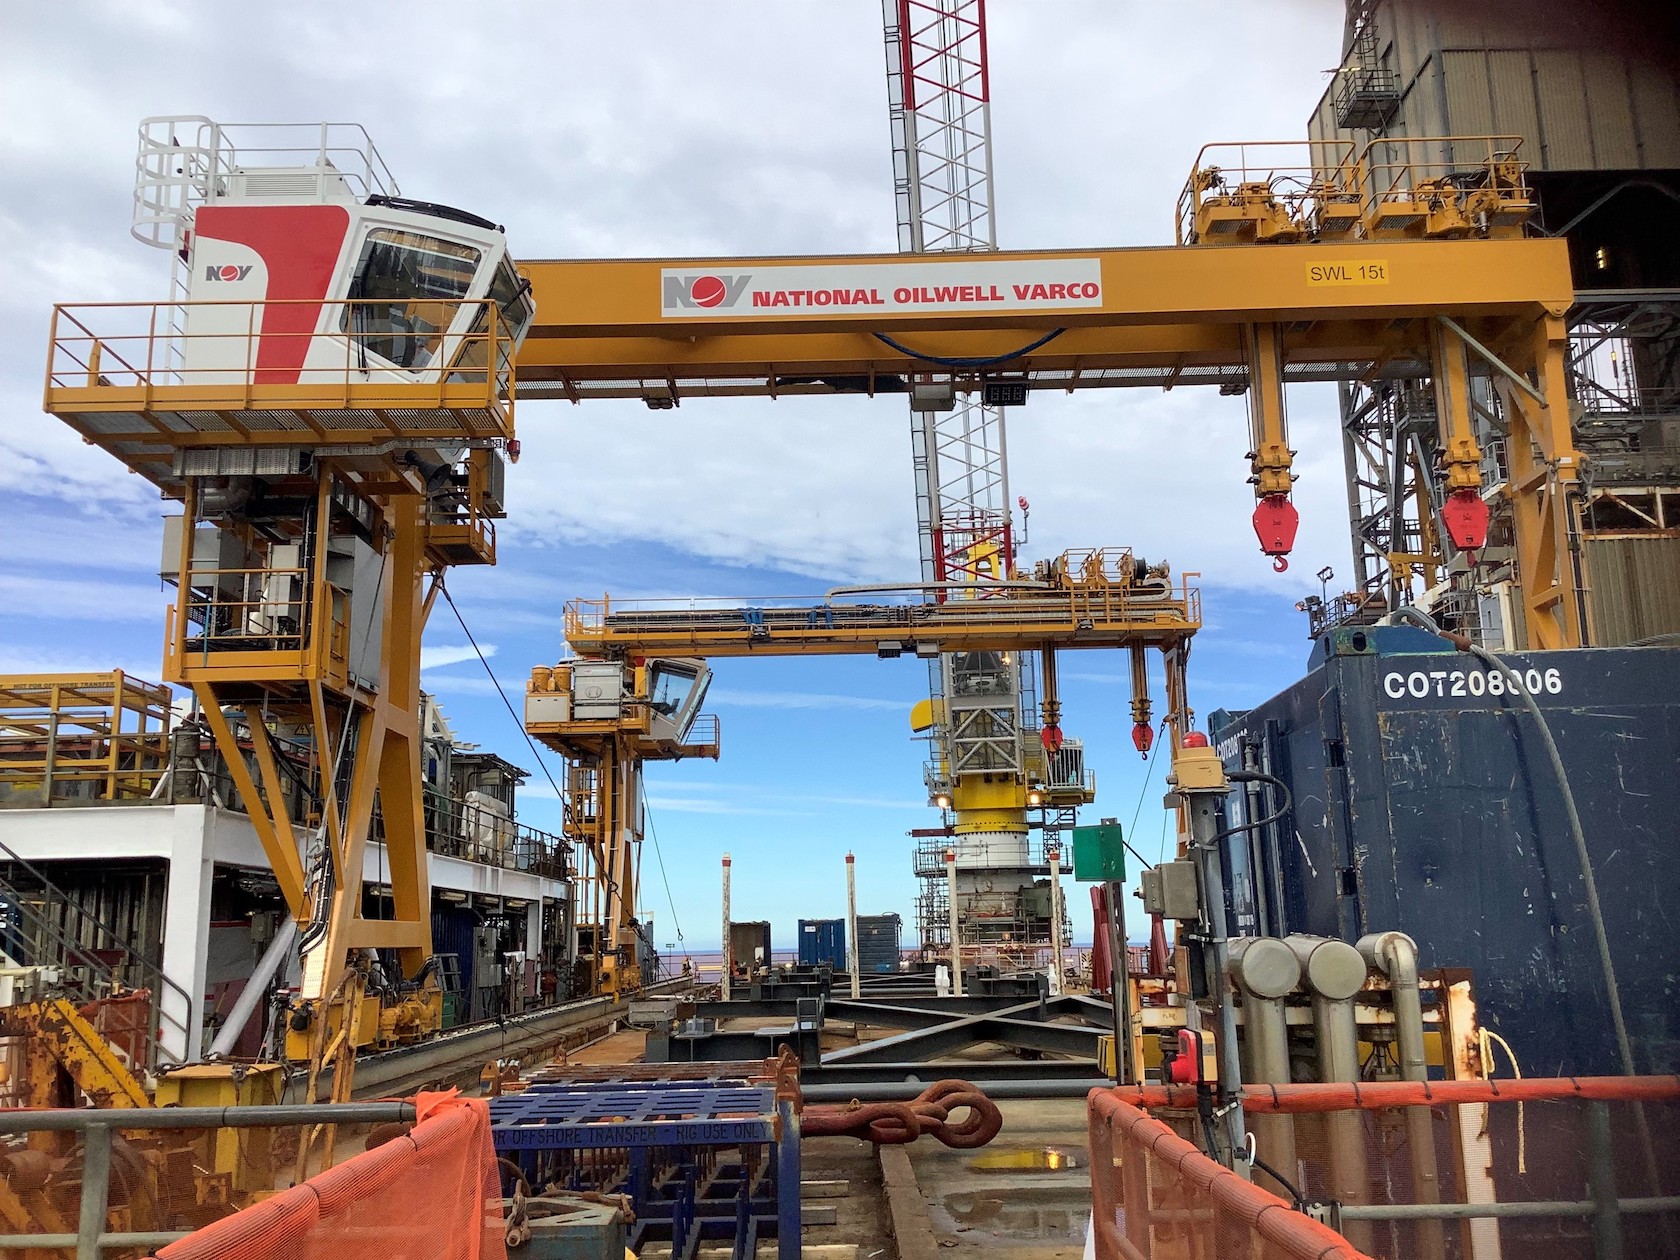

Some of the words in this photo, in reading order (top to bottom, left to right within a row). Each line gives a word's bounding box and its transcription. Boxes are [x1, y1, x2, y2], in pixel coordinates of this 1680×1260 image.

[206, 265, 253, 282] NOV
[1310, 266, 1352, 281] SWL
[1359, 265, 1385, 279] 15t
[664, 275, 752, 308] NOV
[752, 289, 885, 307] NATIONAL
[893, 285, 1005, 304] OILWELL
[1013, 282, 1100, 300] VARCO
[512, 1128, 580, 1144] OFFSHORE
[589, 1125, 656, 1143] TRANSFER
[676, 1124, 697, 1141] RIG
[703, 1123, 728, 1140] USE
[734, 1121, 767, 1139] ONLY
